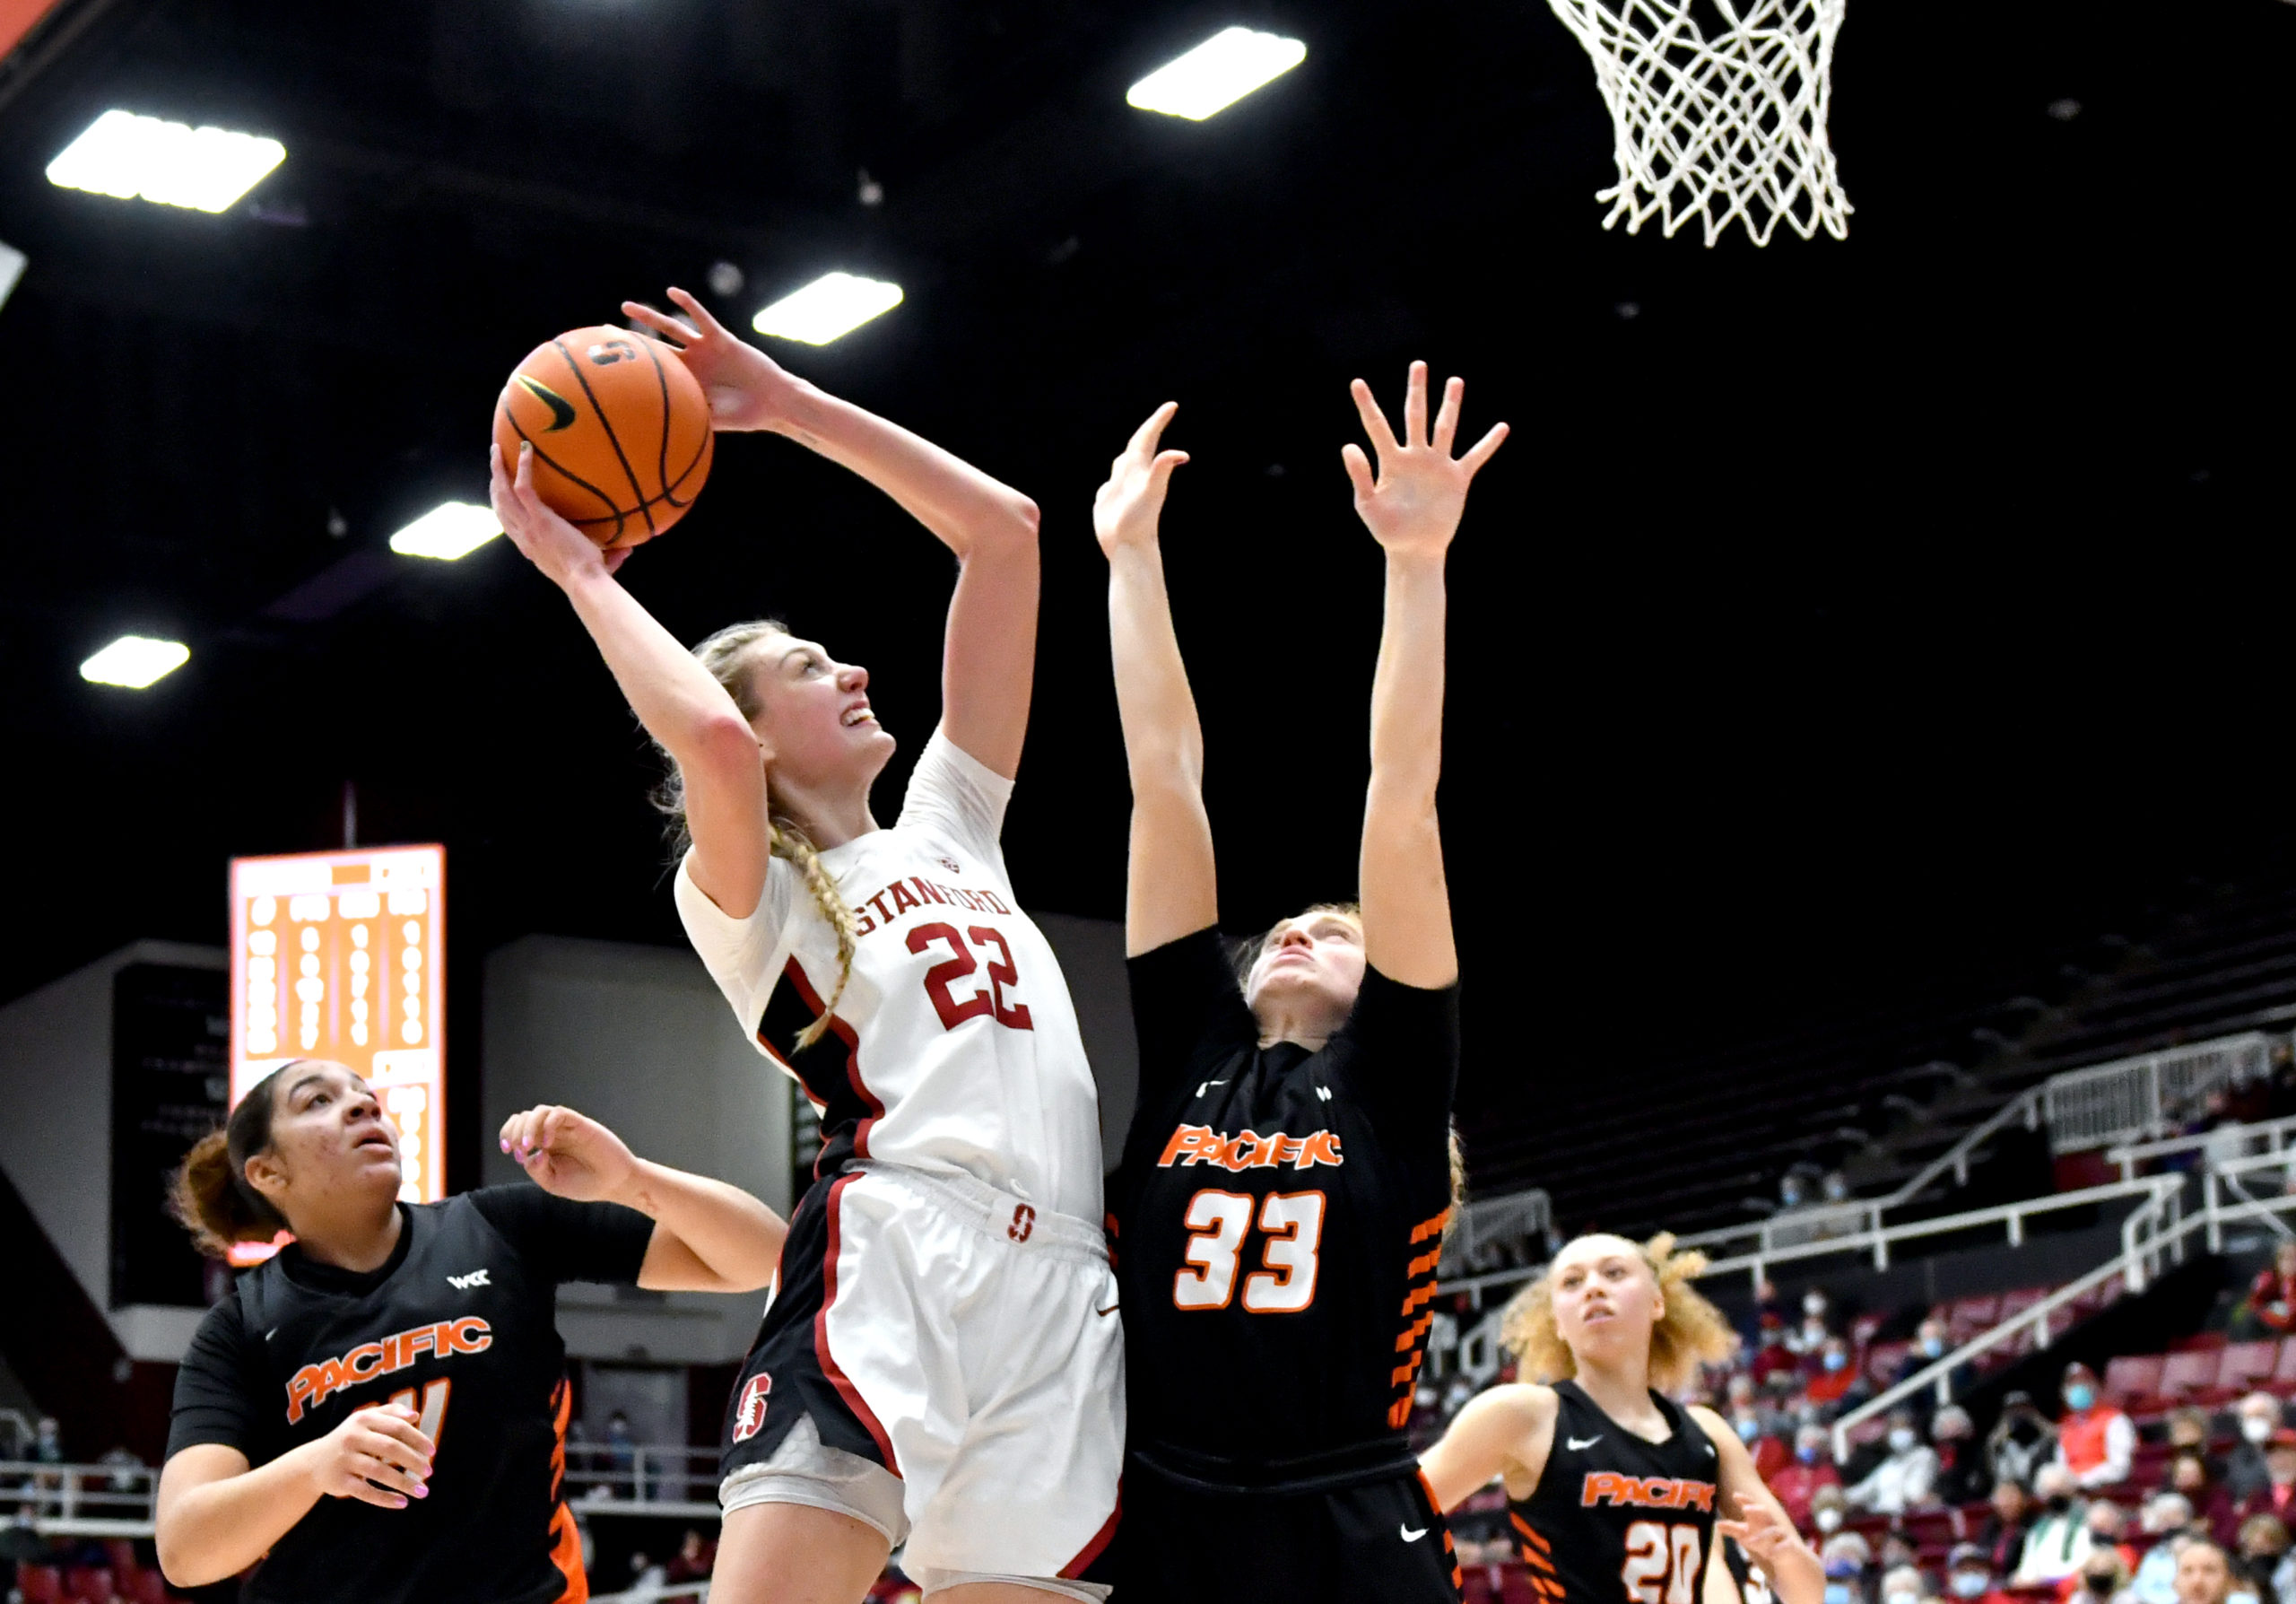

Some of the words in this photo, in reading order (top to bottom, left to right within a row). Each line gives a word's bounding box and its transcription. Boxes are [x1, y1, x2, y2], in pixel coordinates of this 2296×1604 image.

[904, 921, 1034, 1032] 22
[1173, 1188, 1326, 1313] 33
[285, 1315, 492, 1425] PACIFIC
[1621, 1519, 1702, 1604] 20
